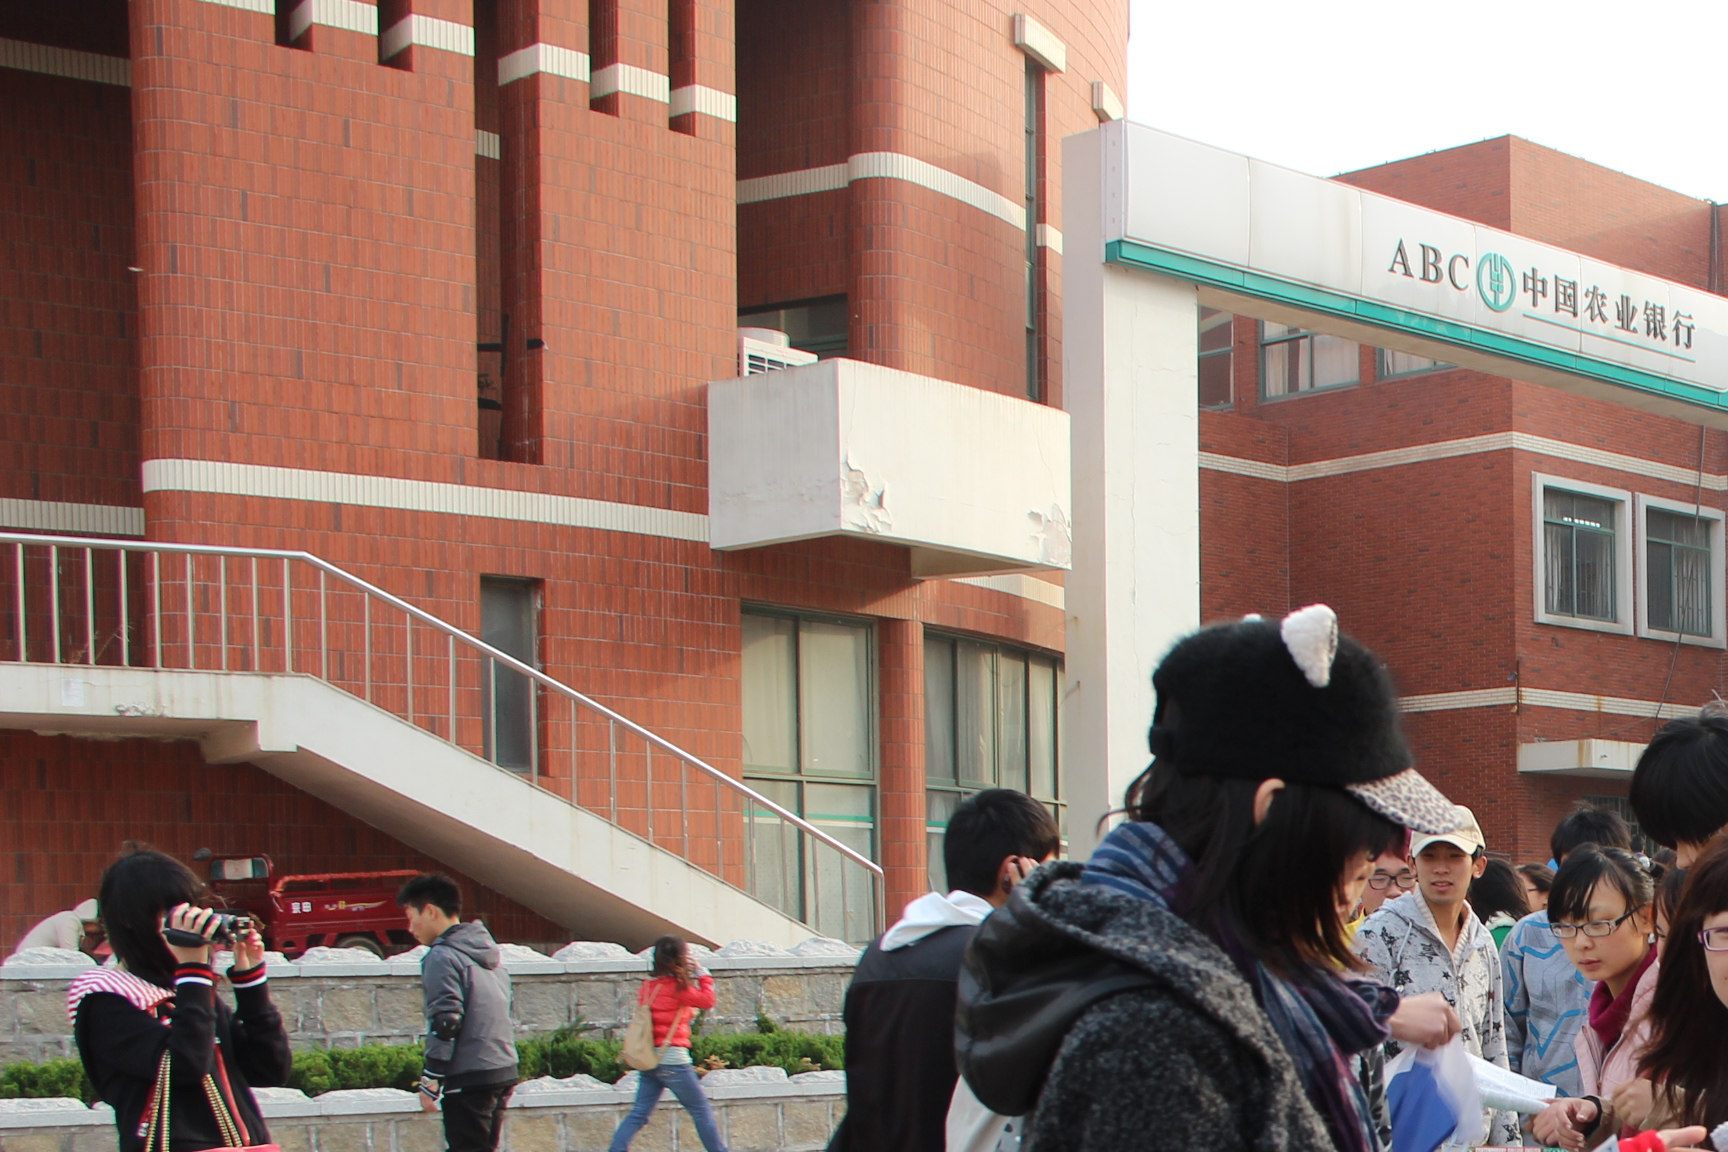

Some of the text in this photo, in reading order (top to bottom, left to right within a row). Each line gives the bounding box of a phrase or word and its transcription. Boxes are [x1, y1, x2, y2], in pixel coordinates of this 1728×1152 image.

[1388, 239, 1696, 349] ABC 中国农业银行
